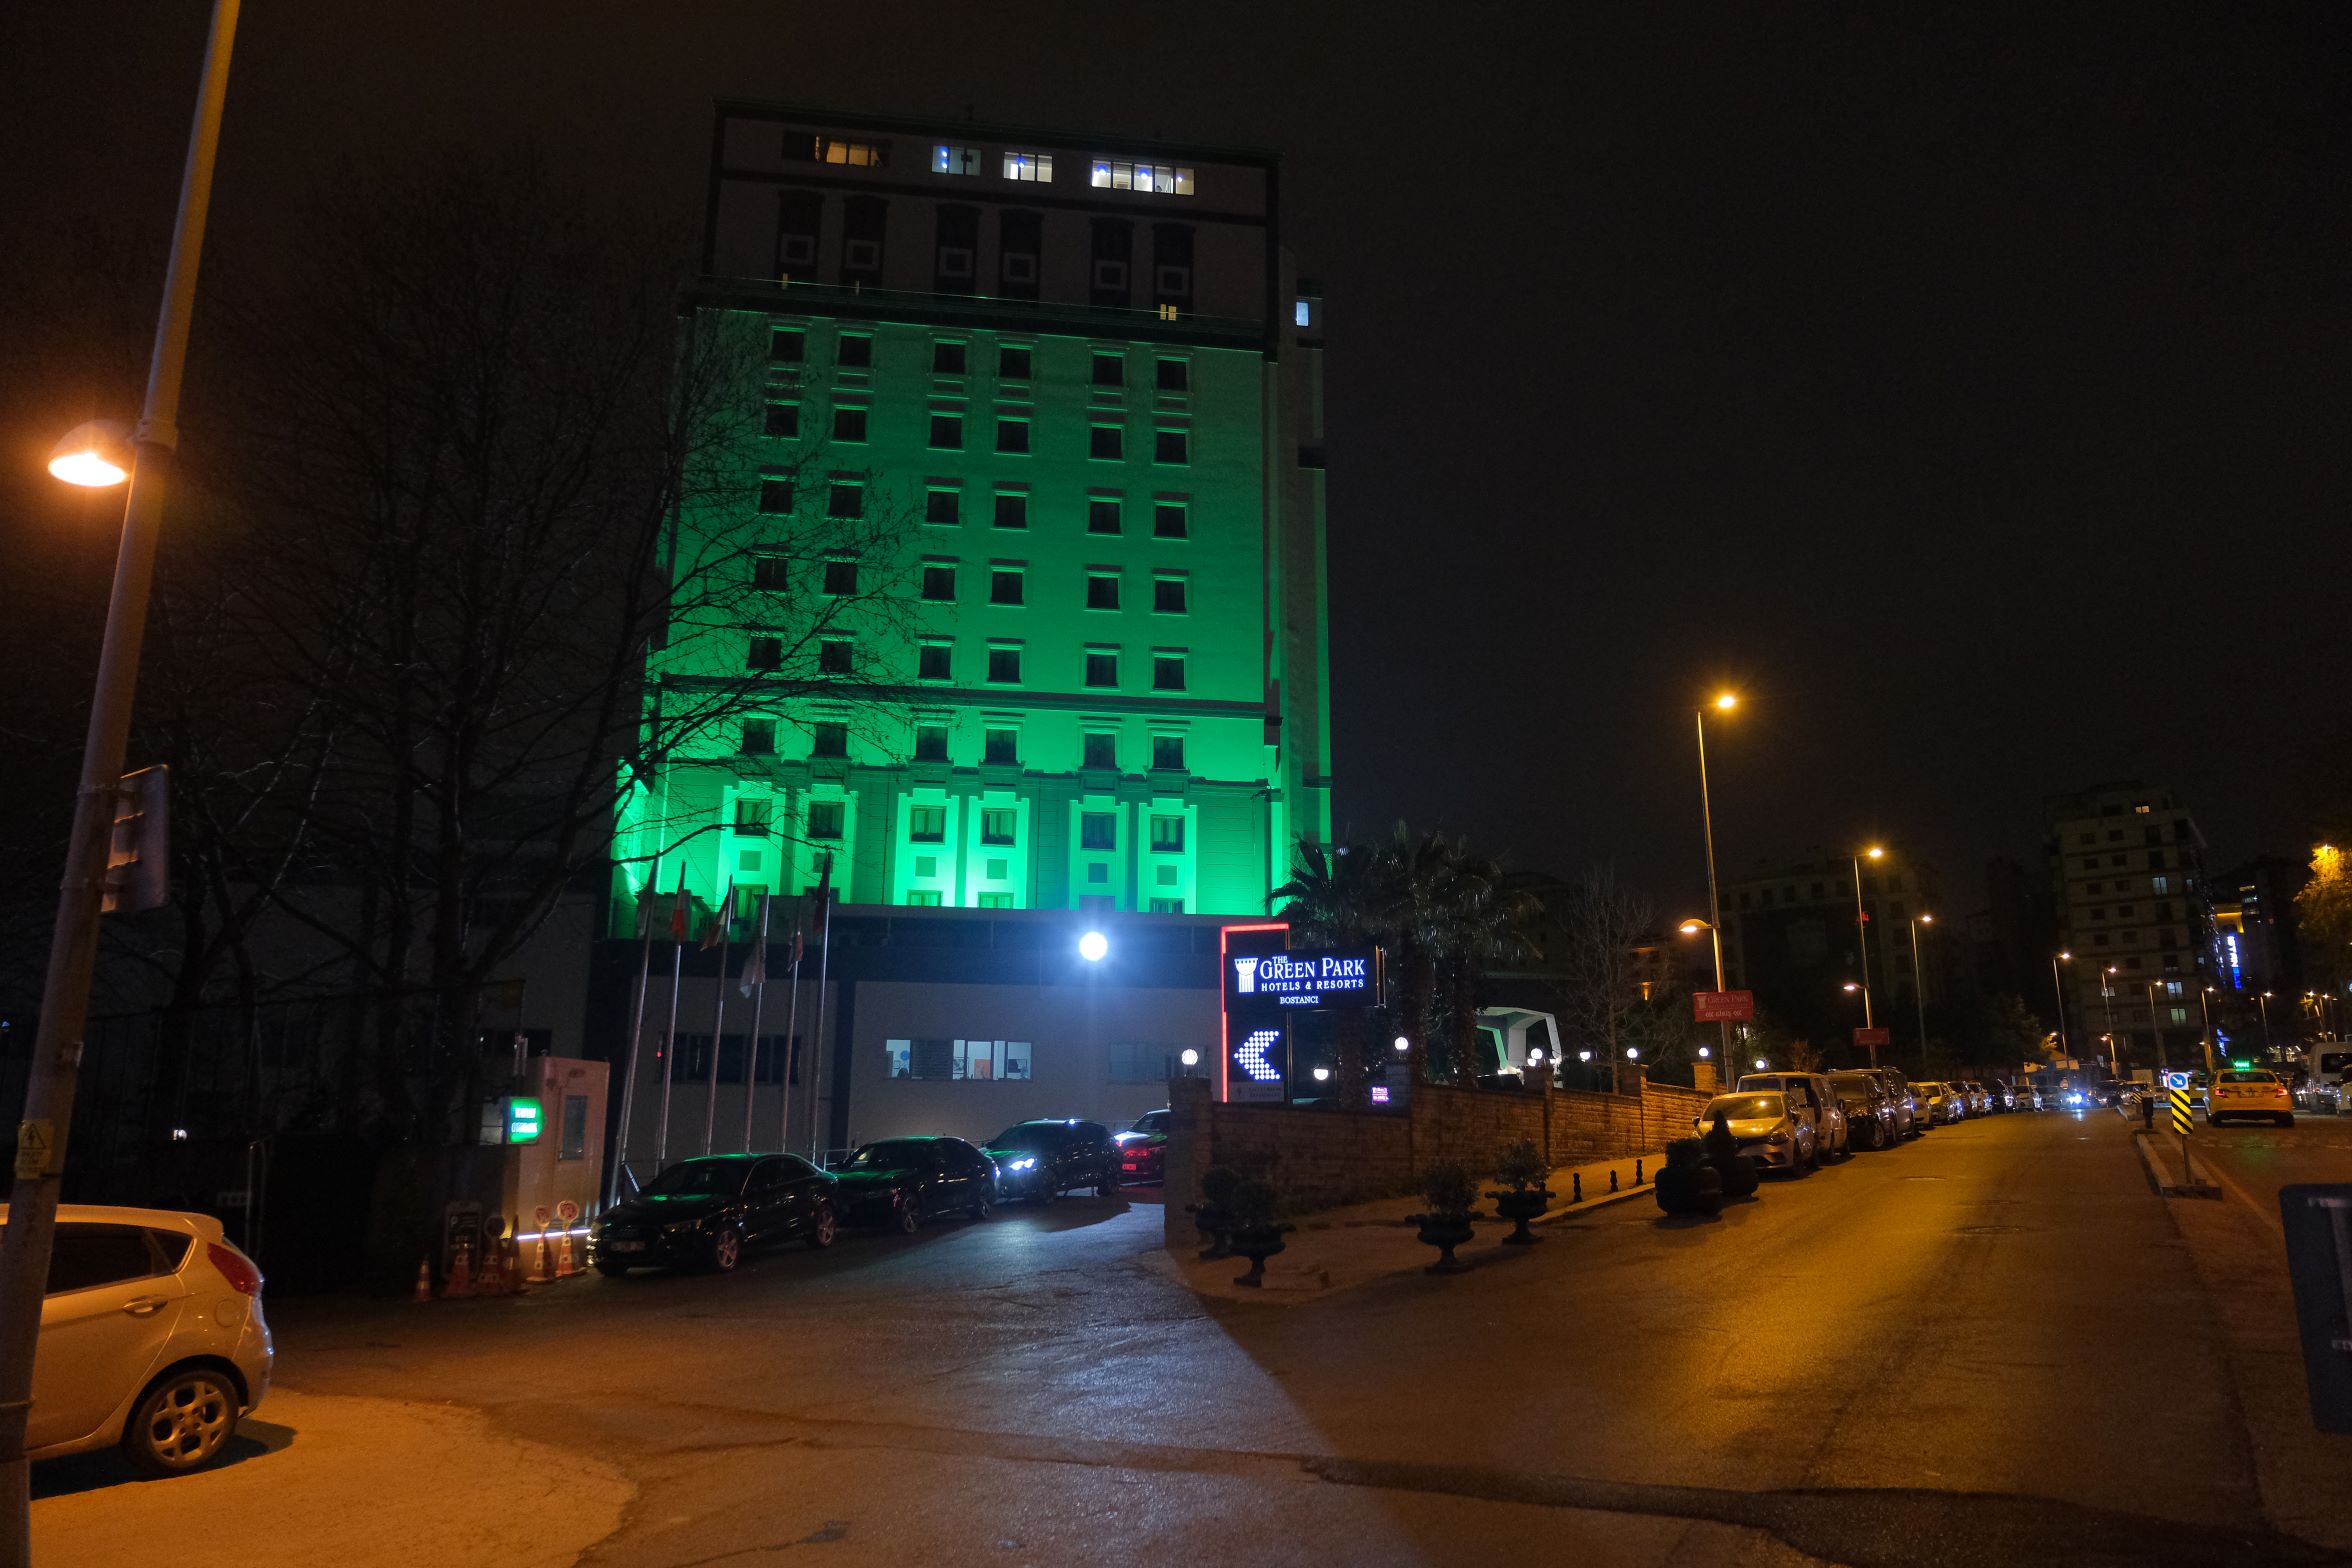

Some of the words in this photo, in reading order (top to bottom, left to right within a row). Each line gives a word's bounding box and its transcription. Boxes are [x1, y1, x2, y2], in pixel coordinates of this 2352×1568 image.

[1272, 956, 1288, 964] THE
[1260, 961, 1315, 980] GREEN
[1321, 957, 1365, 977] PARK
[1261, 982, 1300, 992] HOTELS
[1305, 981, 1311, 990] &
[1317, 979, 1364, 990] RESORTS
[1280, 996, 1319, 1005] BOSTANCI
